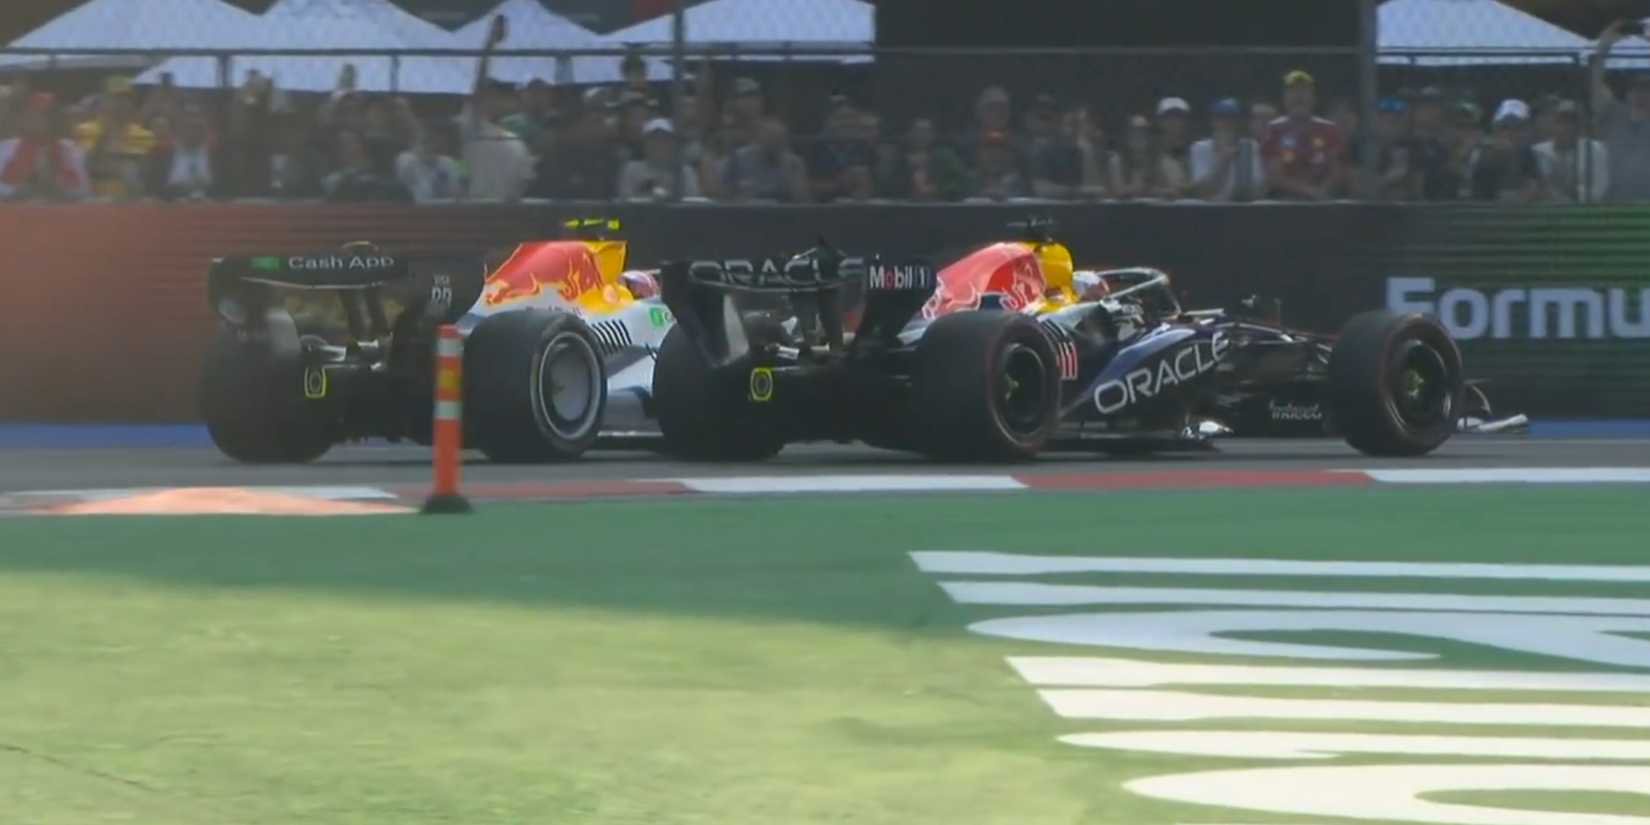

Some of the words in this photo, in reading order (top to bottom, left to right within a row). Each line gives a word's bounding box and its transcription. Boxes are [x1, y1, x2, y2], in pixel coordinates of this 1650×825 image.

[288, 255, 344, 270] Cash
[869, 265, 913, 289] Mobil
[1386, 276, 1650, 339] Formu
[1094, 331, 1230, 413] ORACLE
